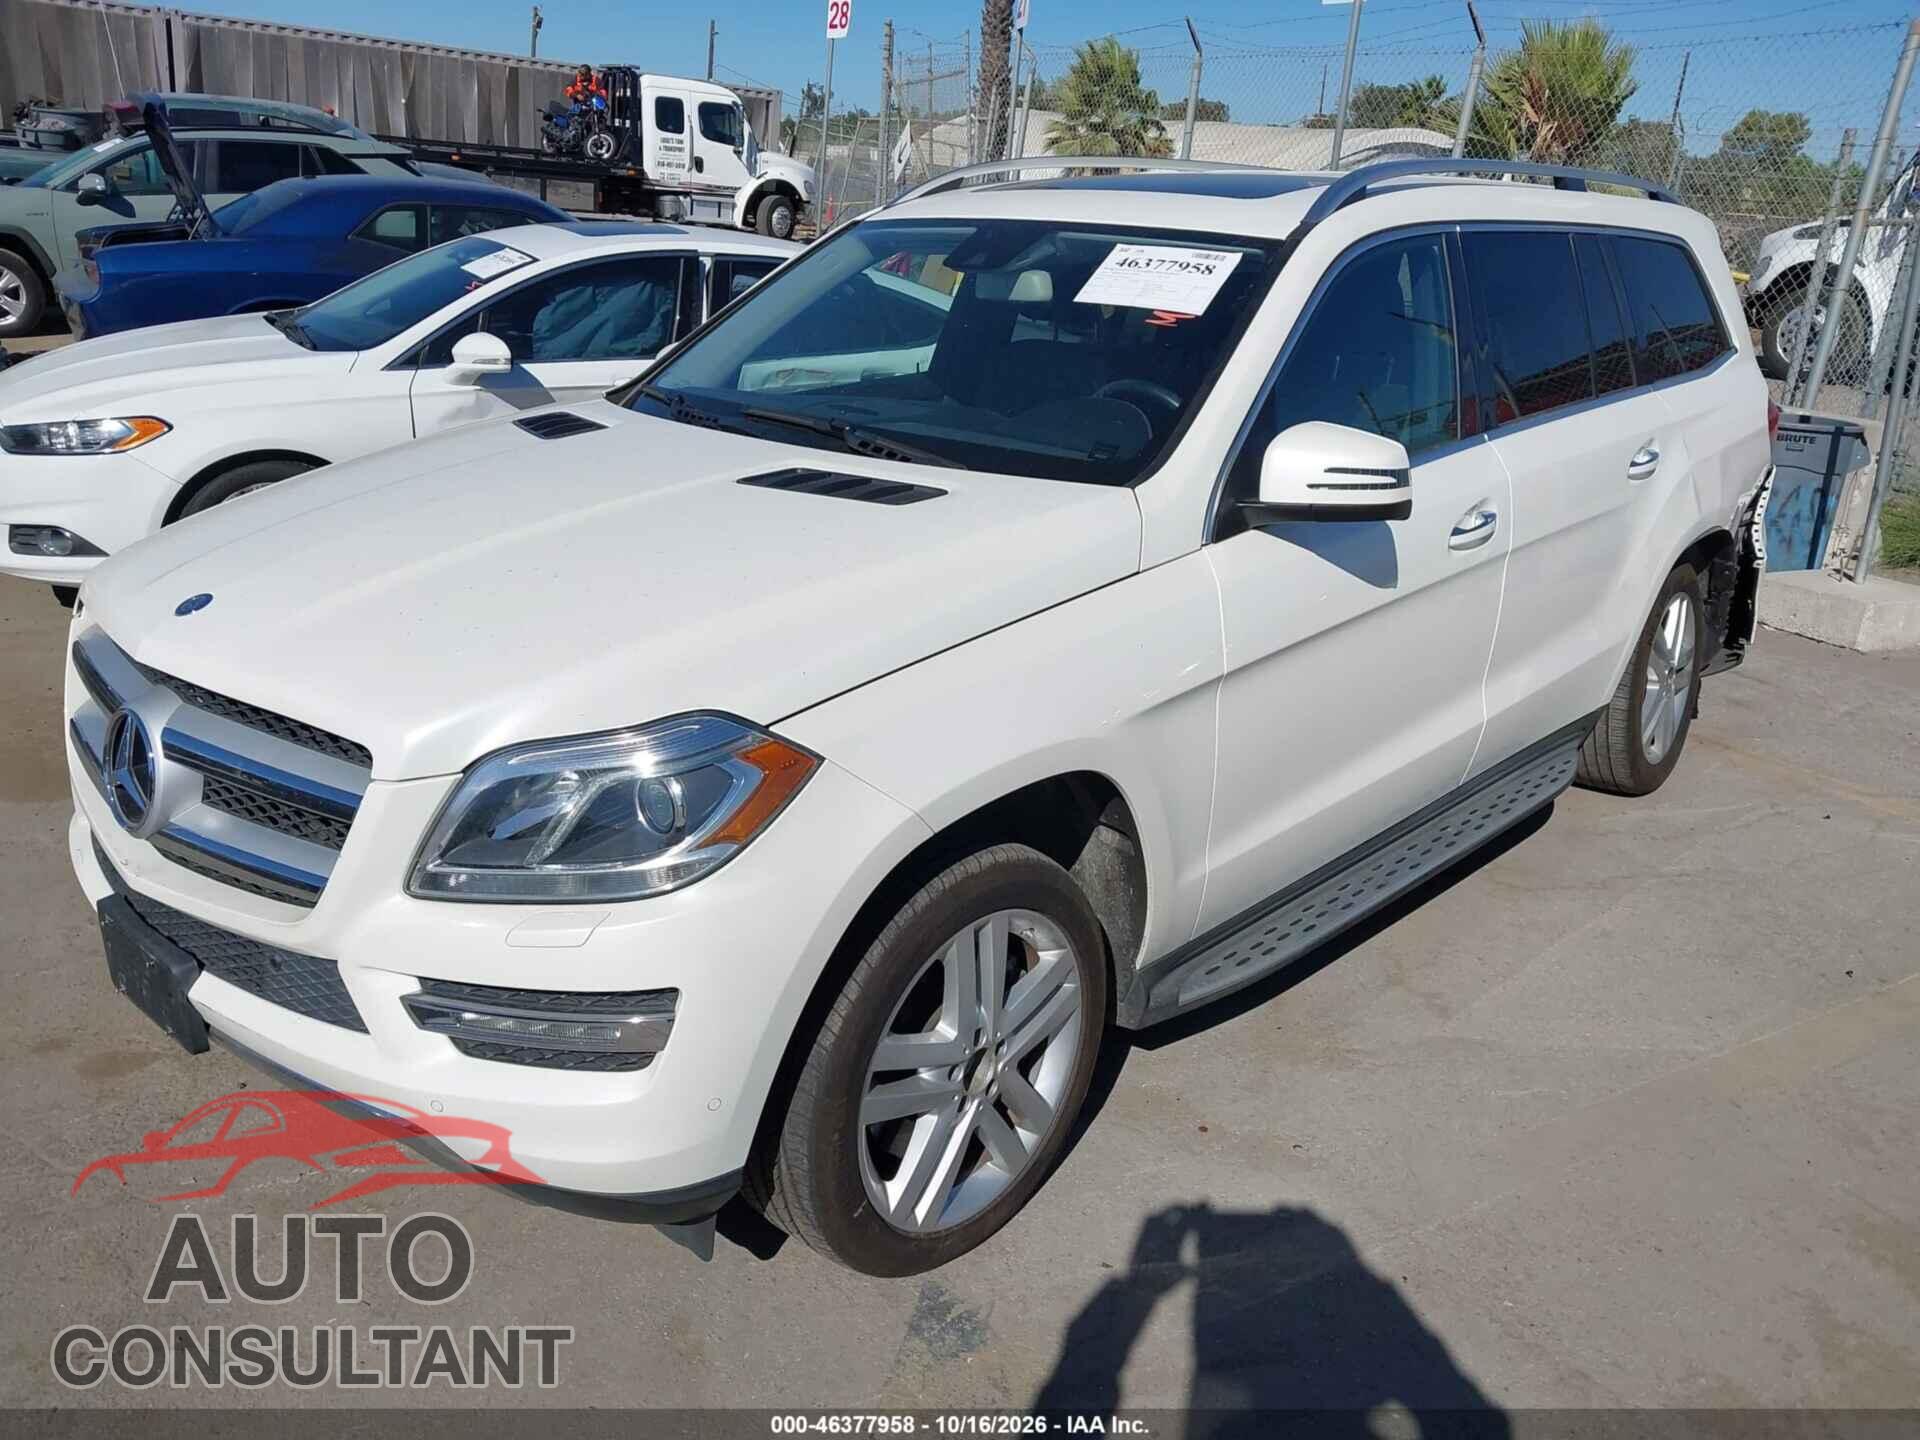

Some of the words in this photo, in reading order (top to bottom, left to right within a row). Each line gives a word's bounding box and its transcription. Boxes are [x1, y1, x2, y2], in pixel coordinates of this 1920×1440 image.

[829, 2, 849, 29] 28
[1115, 256, 1216, 276] 46377958
[1776, 433, 1816, 445] BRUTE
